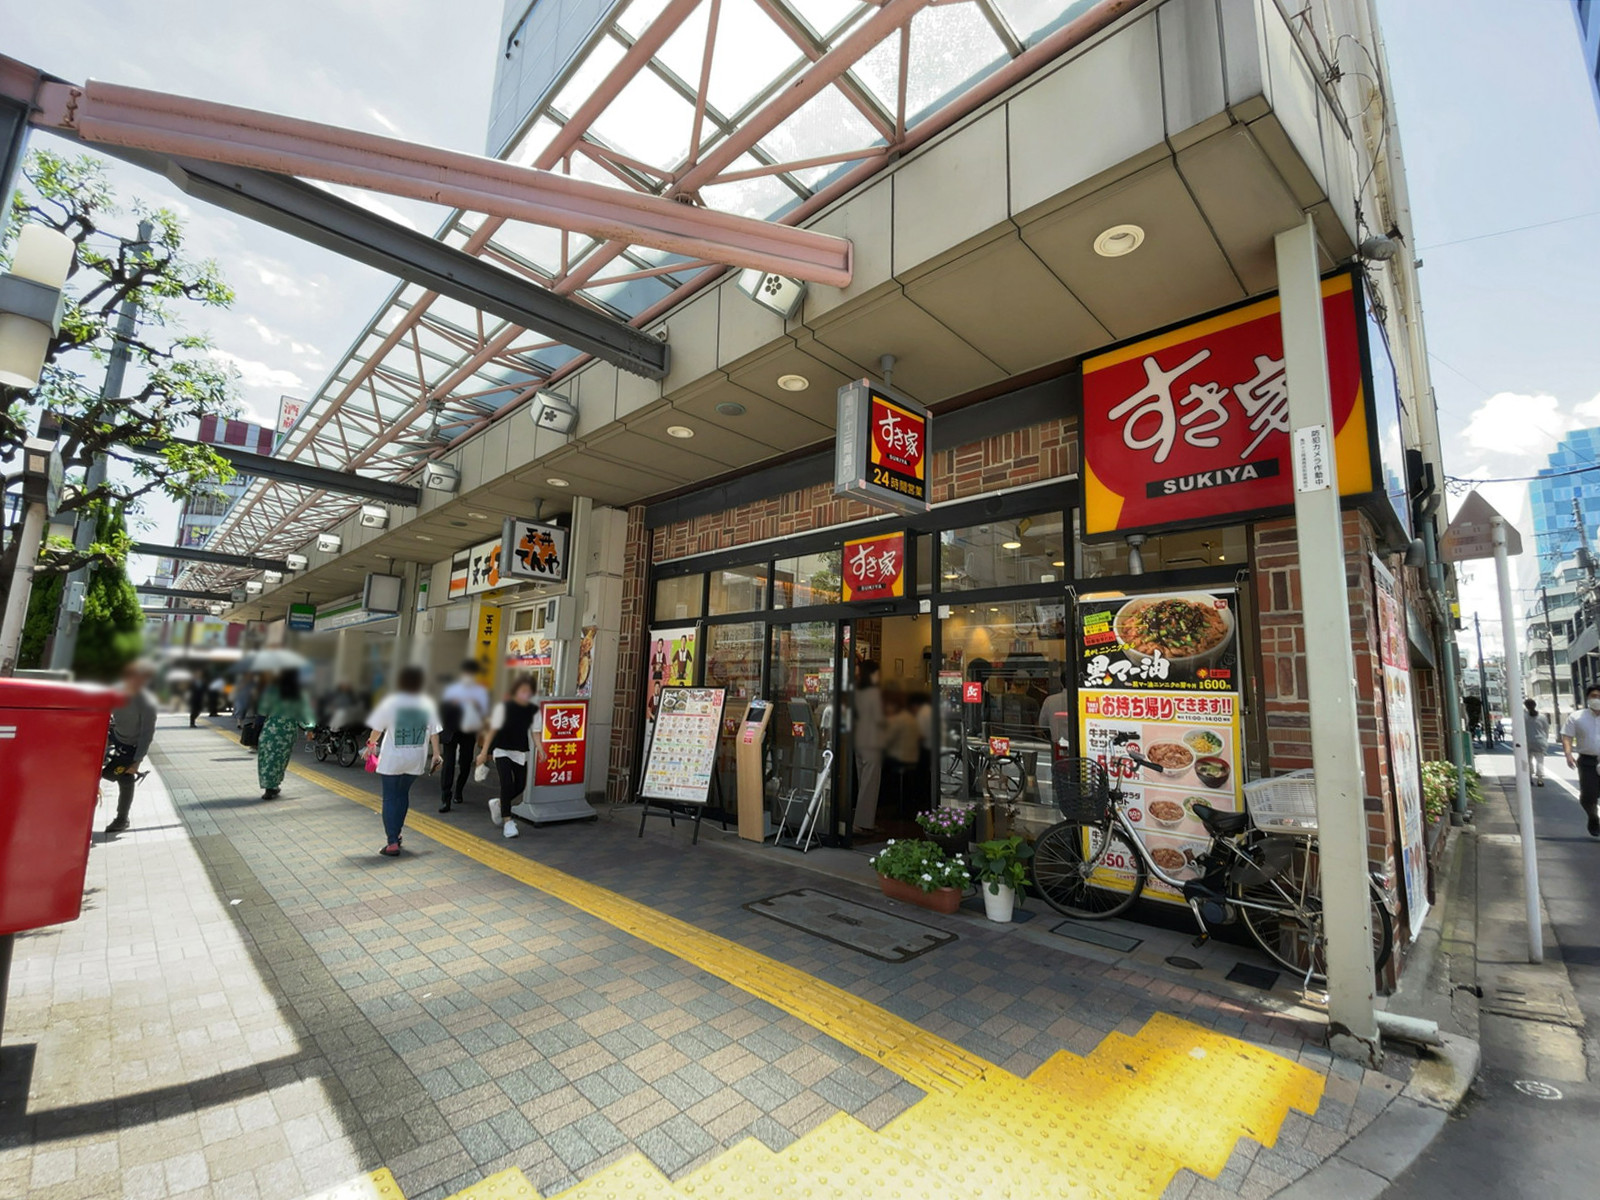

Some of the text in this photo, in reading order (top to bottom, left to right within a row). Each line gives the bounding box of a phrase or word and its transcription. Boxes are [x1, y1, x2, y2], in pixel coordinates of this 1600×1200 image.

[1108, 349, 1290, 463] すき家
[878, 409, 919, 458] すき家
[889, 454, 908, 465] SUKIYA
[1311, 429, 1324, 486] 防犯カメラ作動中
[1163, 464, 1258, 495] SUKIYA
[526, 527, 553, 544] 天丼
[515, 548, 560, 574] てんや
[849, 544, 896, 582] すき家
[1084, 649, 1170, 686] 黒マー油
[550, 709, 580, 731] すき家
[549, 742, 577, 756] 牛丼
[547, 757, 577, 770] カレー
